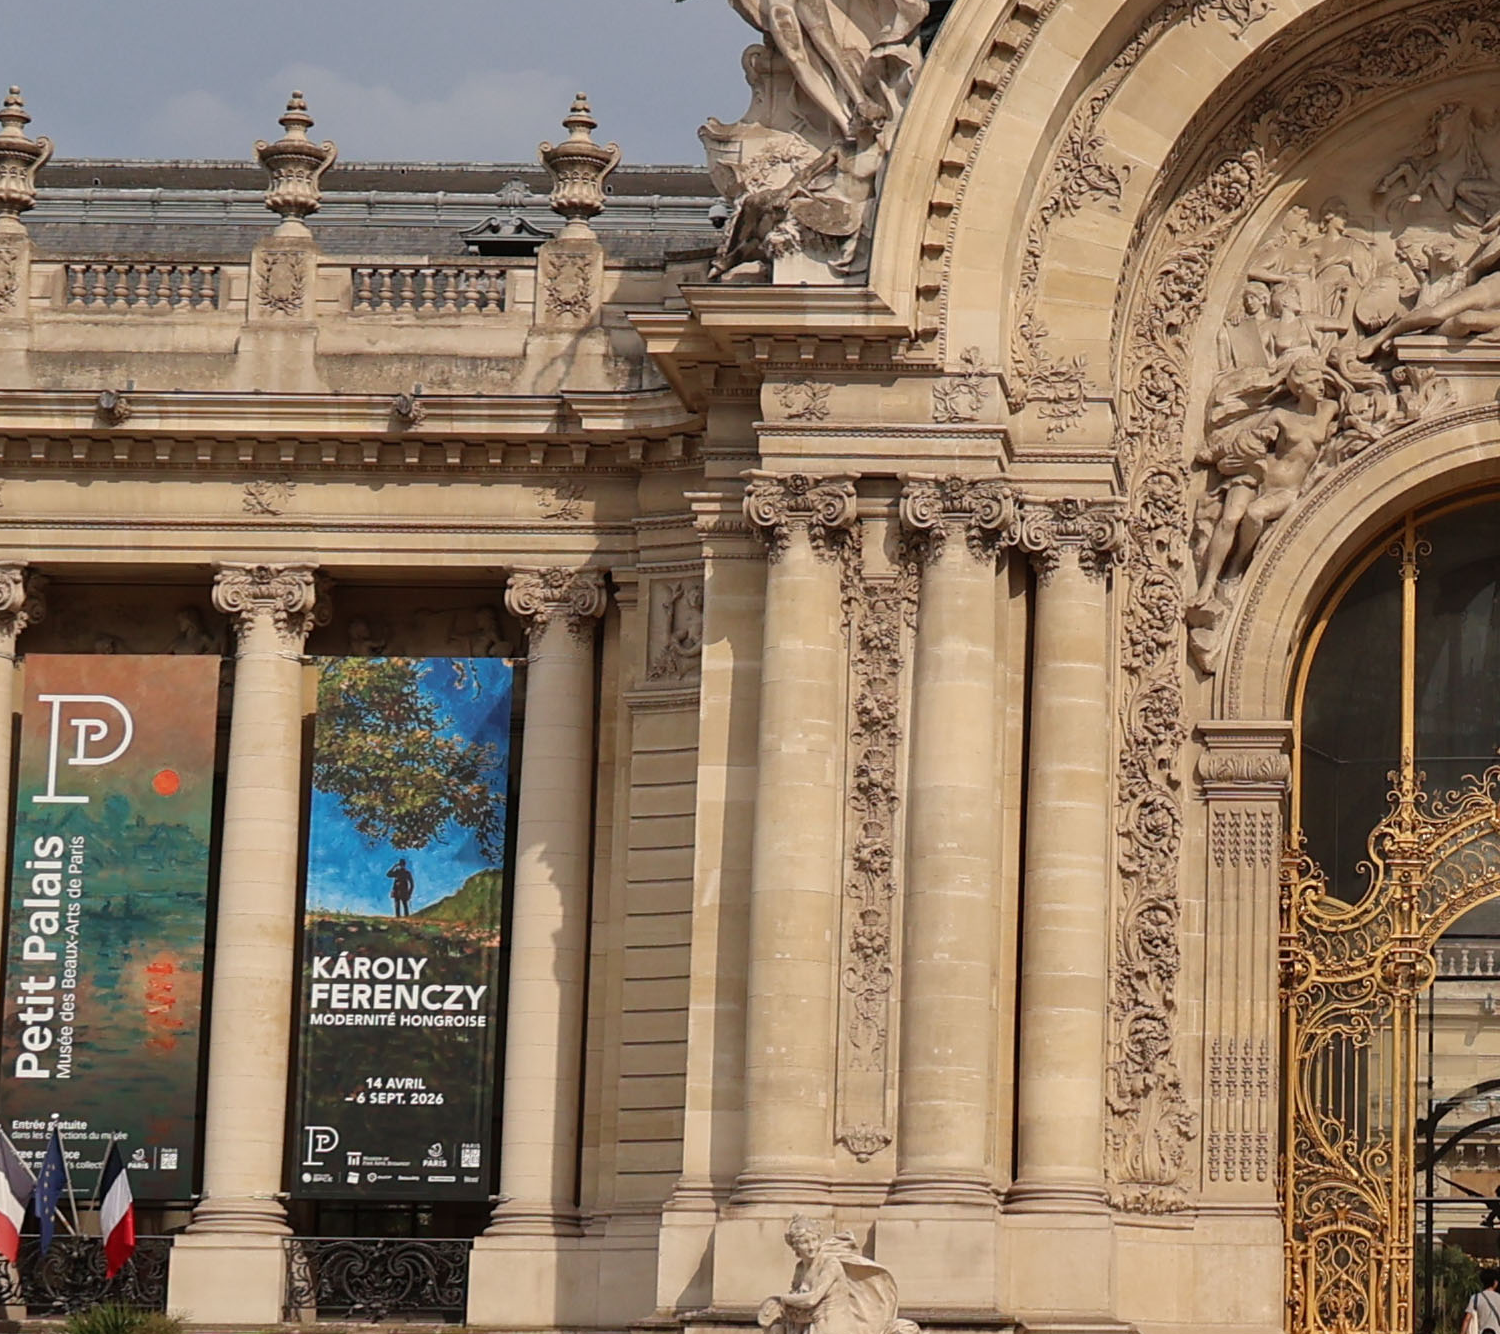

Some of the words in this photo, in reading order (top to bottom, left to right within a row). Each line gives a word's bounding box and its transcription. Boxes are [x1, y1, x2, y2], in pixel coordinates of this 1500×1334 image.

[68, 835, 85, 875] Paris
[22, 835, 65, 962] Palais
[65, 877, 83, 899] de
[61, 901, 82, 989] Beaux-Arts
[312, 951, 428, 980] KÁROLY
[59, 992, 76, 1022] des
[310, 983, 487, 1011] FERENCZY
[15, 975, 57, 1079] Petit
[309, 1012, 397, 1027] MODERNITÉ
[400, 1014, 487, 1028] HONGROISE
[56, 1025, 74, 1079] Musée
[366, 1077, 383, 1090] 14
[385, 1077, 427, 1090] AVRIL
[356, 1092, 366, 1104] 6
[369, 1092, 407, 1105] SEPT.
[410, 1093, 444, 1105] 2026
[12, 1119, 46, 1130] Entrée
